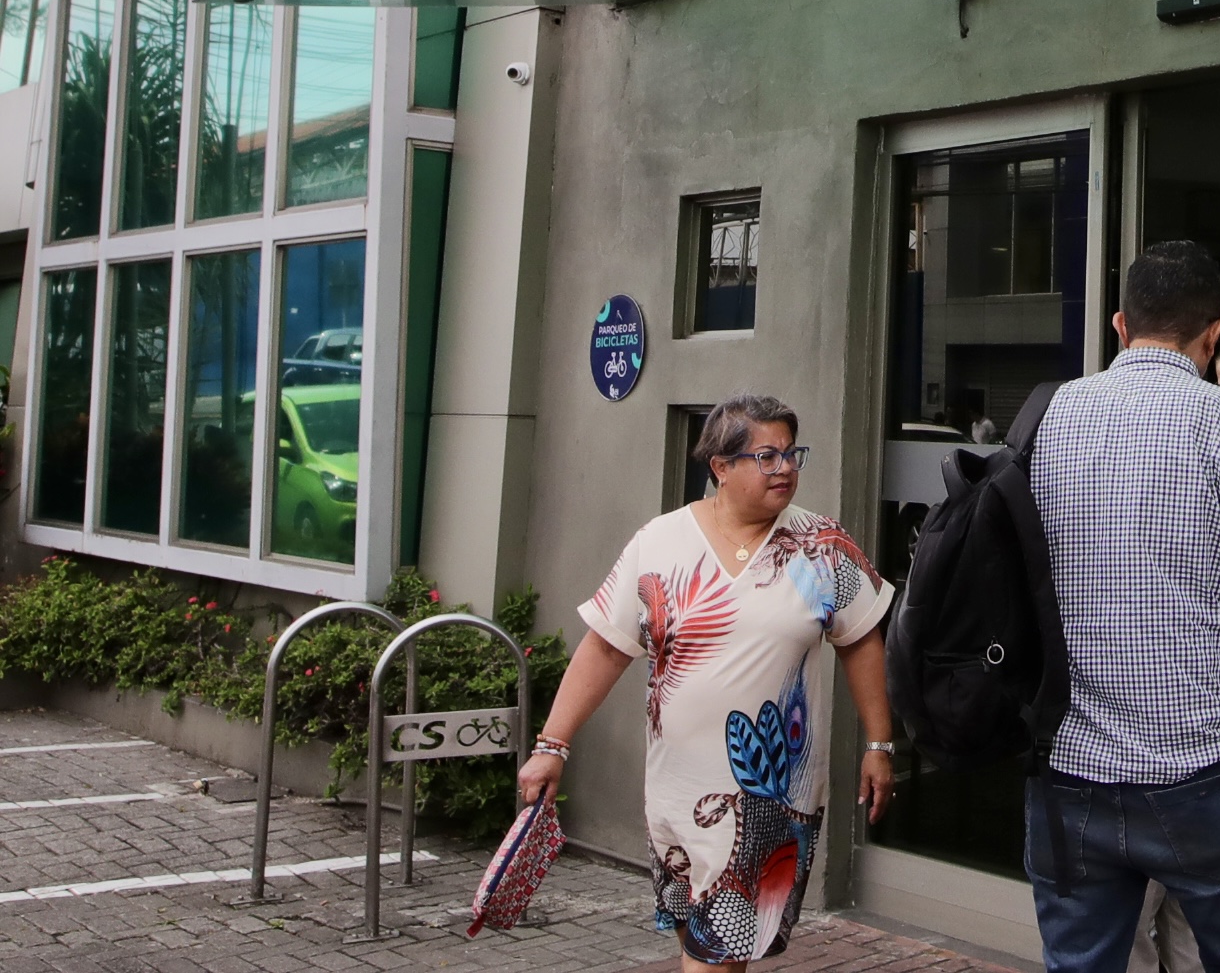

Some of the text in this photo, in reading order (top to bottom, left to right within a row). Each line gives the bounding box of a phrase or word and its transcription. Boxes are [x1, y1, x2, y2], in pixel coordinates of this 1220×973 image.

[598, 322, 637, 335] PARQUEO DE
[595, 334, 639, 348] BICICLETAS
[390, 720, 447, 752] CS
